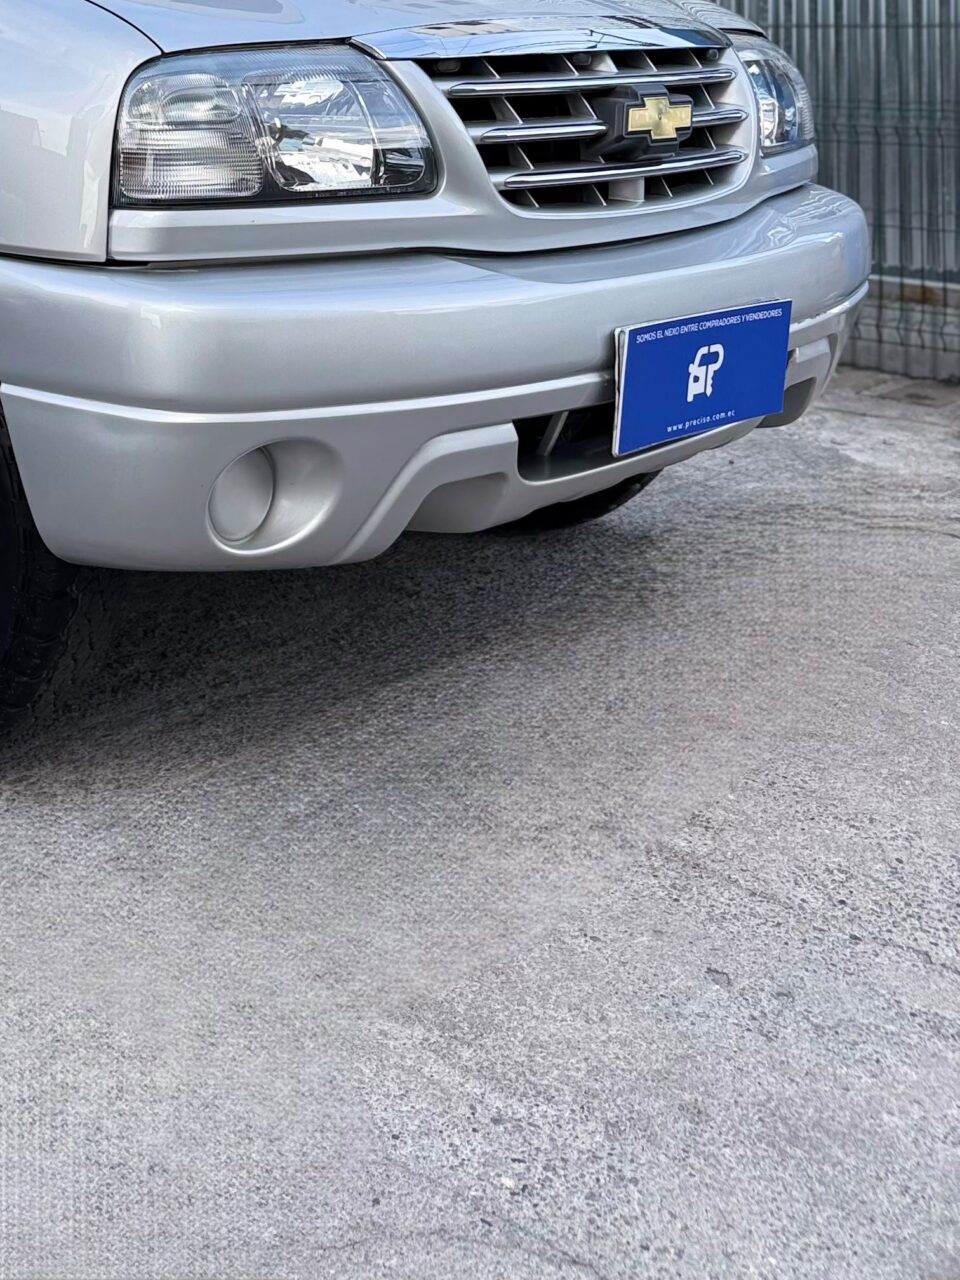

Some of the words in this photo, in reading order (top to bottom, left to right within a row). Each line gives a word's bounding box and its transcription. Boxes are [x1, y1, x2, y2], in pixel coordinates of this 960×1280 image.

[636, 331, 656, 344] SOMOS
[657, 330, 664, 339] EL
[664, 326, 680, 337] NEXO
[680, 322, 699, 334] ENTRE
[698, 315, 741, 330] COMPRADORES
[745, 308, 783, 321] VENDEDORES
[667, 410, 735, 432] www.preciso.com.ec
